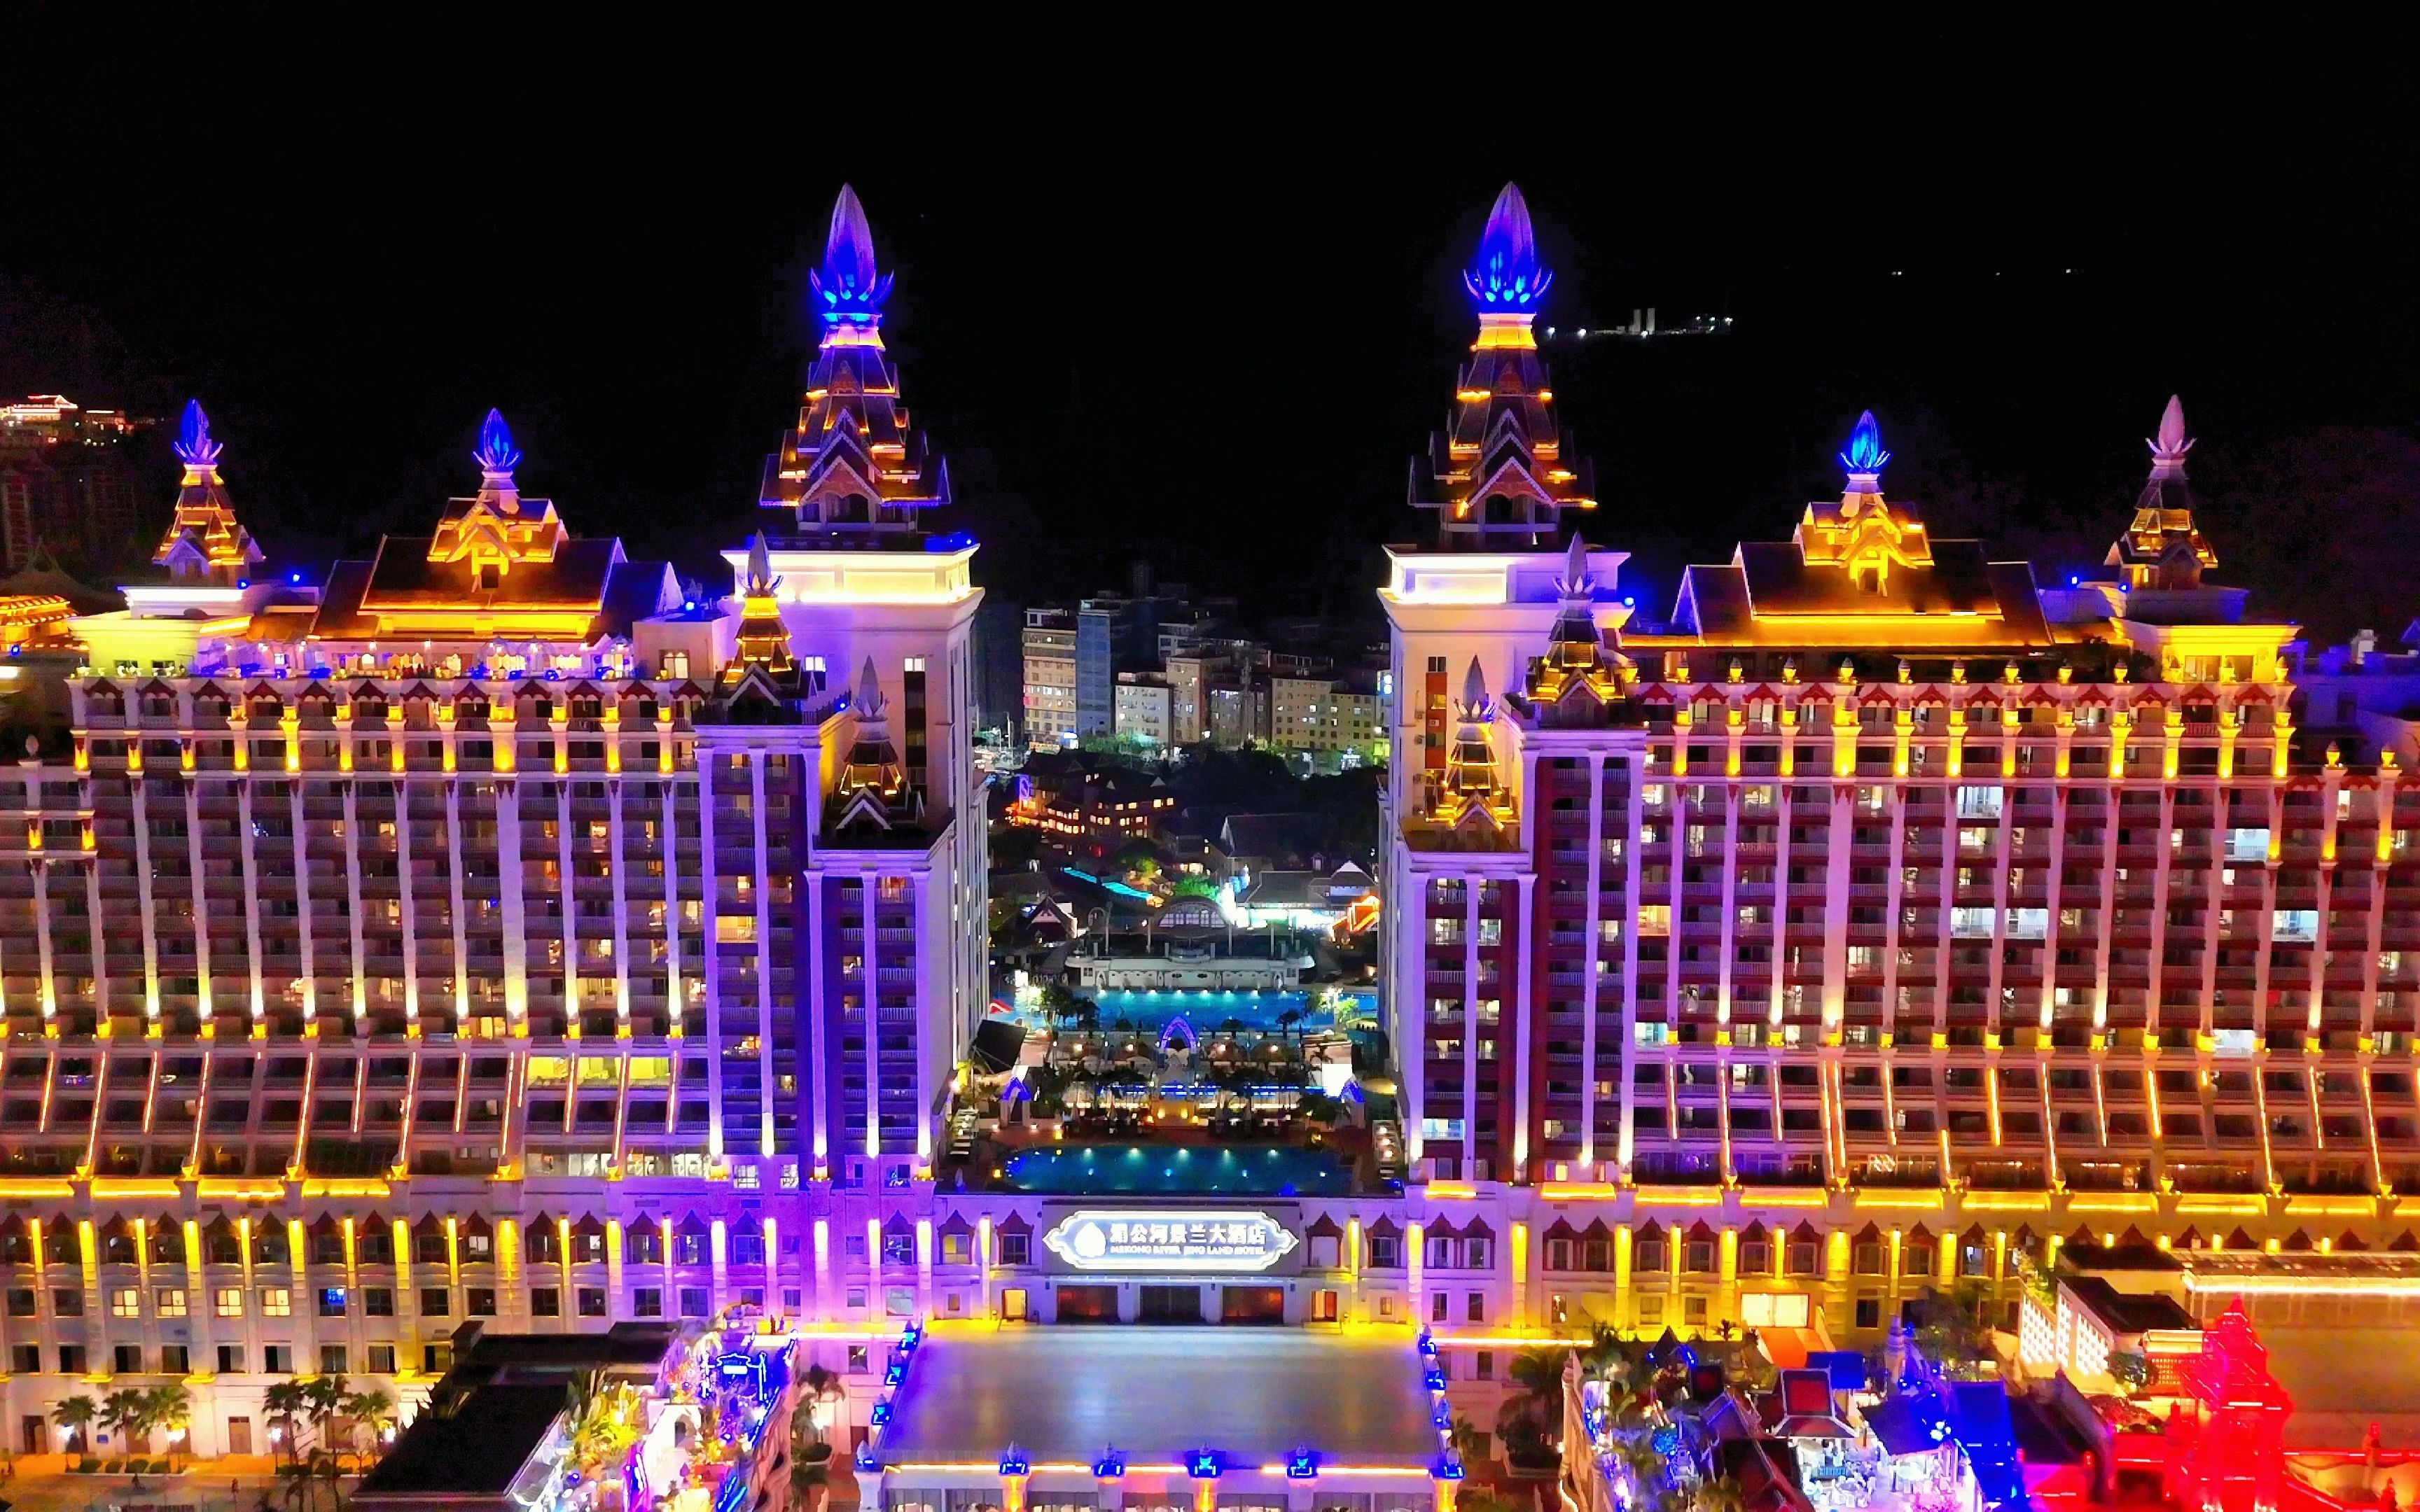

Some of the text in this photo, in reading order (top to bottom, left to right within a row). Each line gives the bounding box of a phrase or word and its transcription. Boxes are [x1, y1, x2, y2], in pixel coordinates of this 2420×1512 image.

[1109, 1224, 1266, 1244] 湄公河景兰大酒店
[1110, 1245, 1152, 1254] MEKONG
[1153, 1245, 1181, 1254] RIVER
[1206, 1246, 1233, 1254] LAND
[1234, 1246, 1266, 1254] HOTEL
